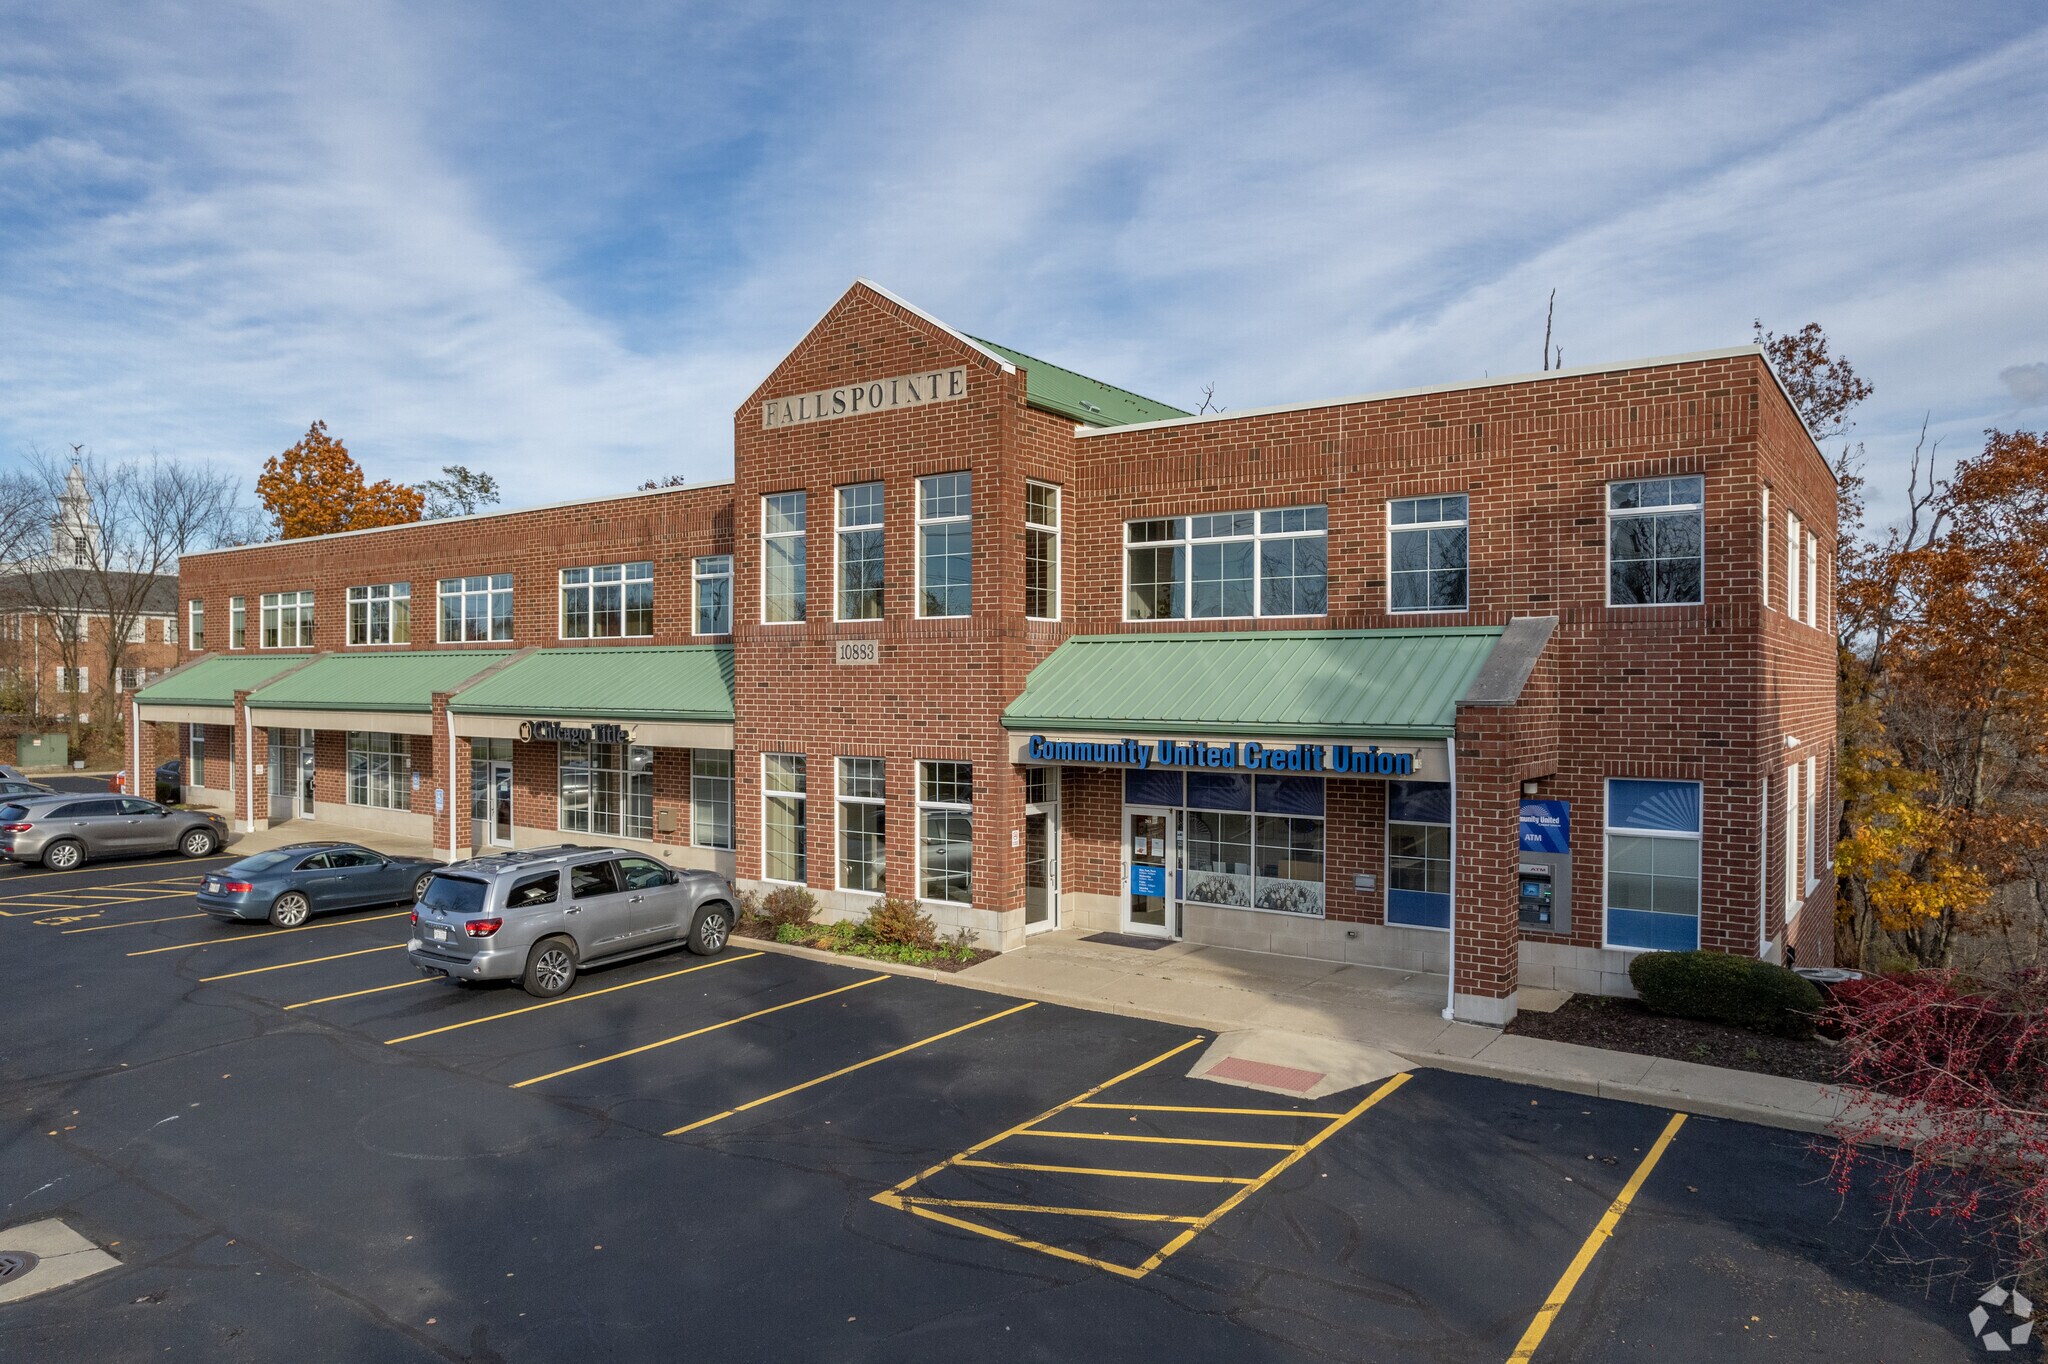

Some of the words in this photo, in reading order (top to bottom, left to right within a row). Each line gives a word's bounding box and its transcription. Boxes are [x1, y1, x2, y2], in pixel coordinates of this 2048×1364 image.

[765, 370, 964, 426] FALLSPOINTE
[840, 644, 874, 660] 10883
[533, 721, 588, 746] Chicago
[591, 724, 626, 744] Title
[1029, 735, 1151, 769] Community
[1158, 740, 1236, 768] United
[1244, 742, 1325, 771] Credit
[1333, 745, 1413, 775] Union
[1540, 816, 1560, 824] United
